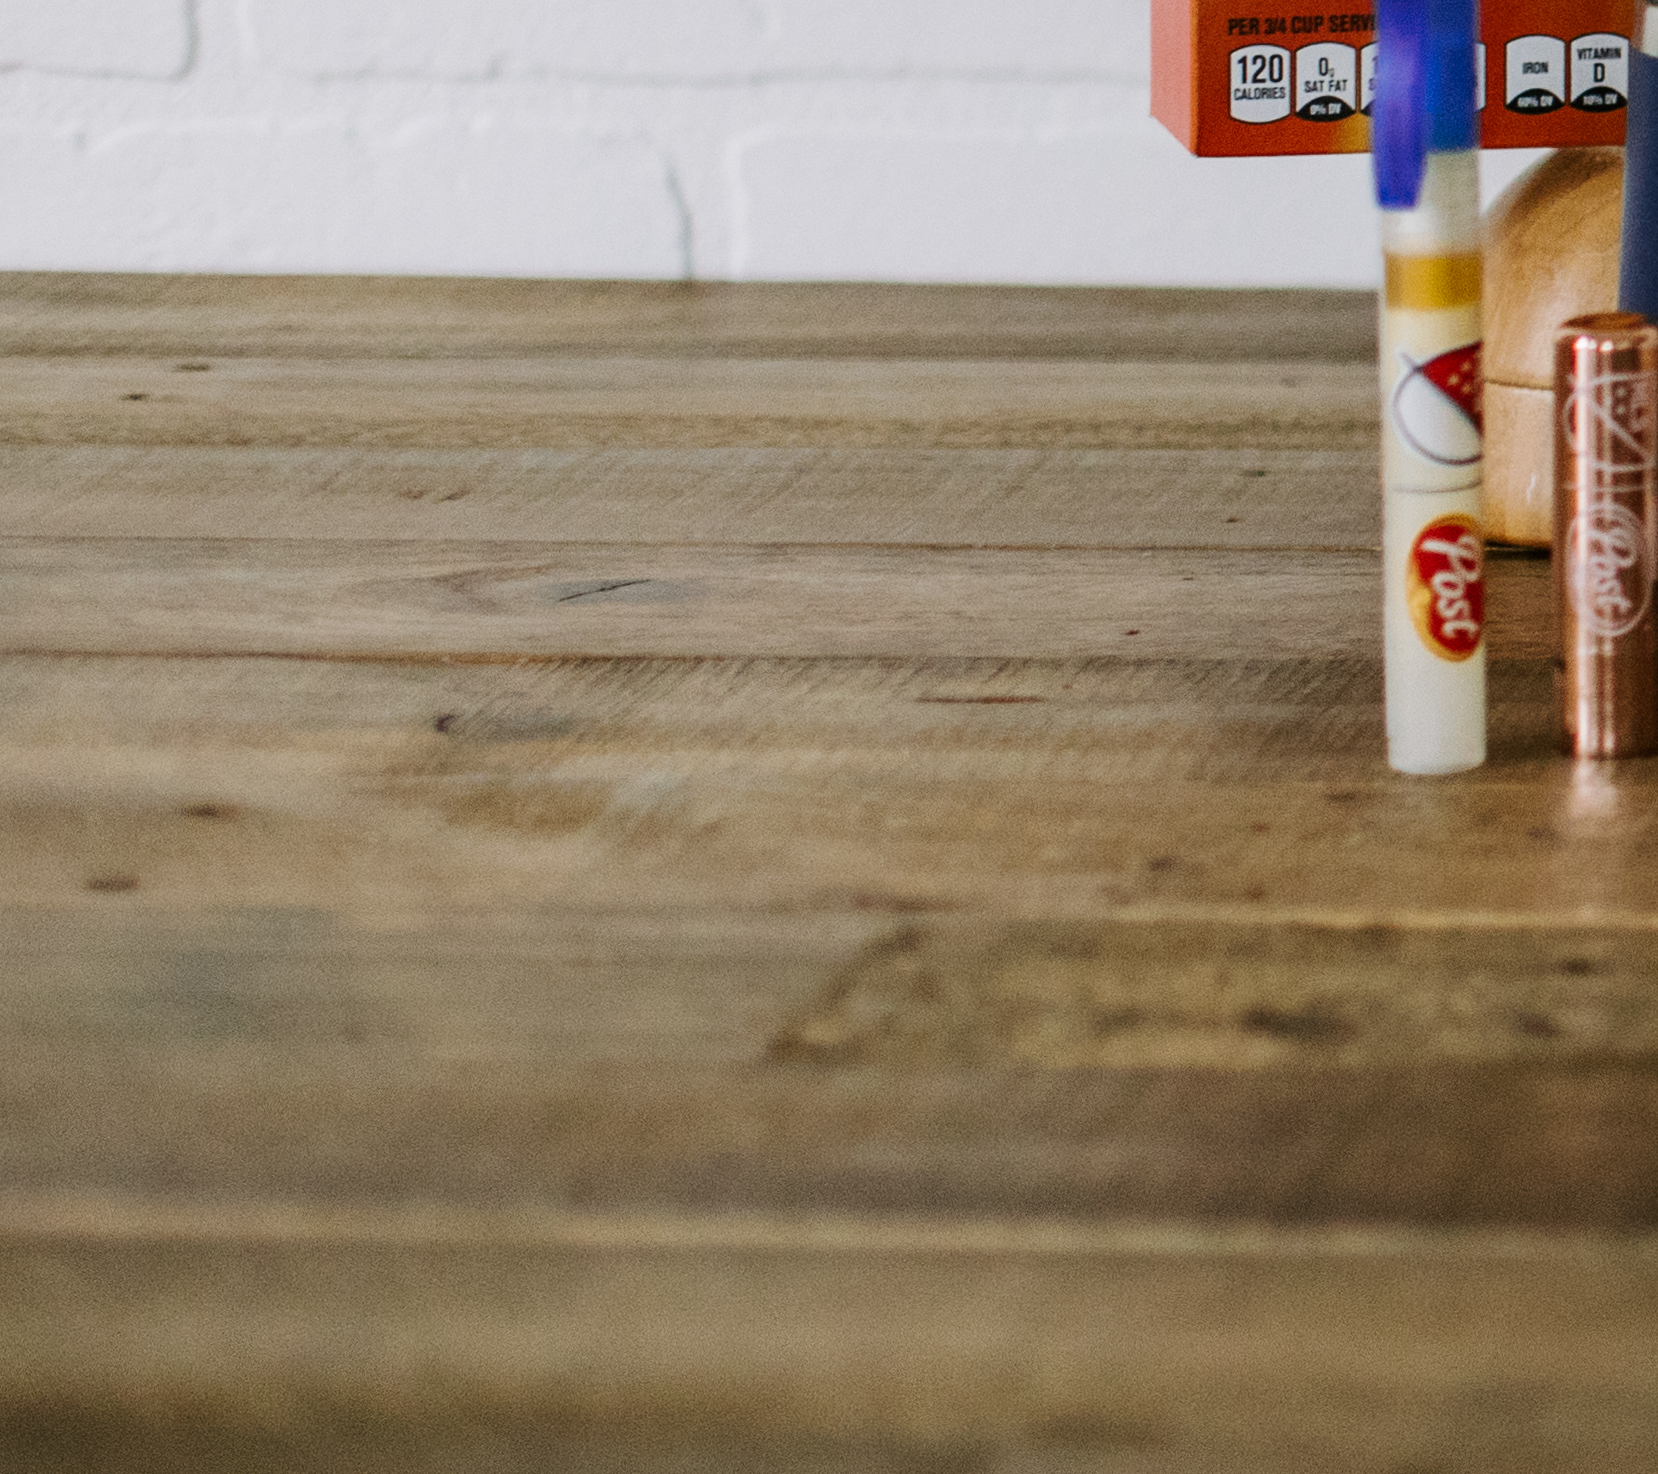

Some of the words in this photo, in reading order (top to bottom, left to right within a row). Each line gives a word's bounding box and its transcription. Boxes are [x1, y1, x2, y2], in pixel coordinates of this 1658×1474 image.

[1227, 17, 1261, 36] PER
[1264, 16, 1287, 35] 3/4
[1291, 15, 1323, 34] CUP
[1577, 47, 1621, 60] VITAMIN
[1236, 53, 1283, 84] 120
[1522, 61, 1548, 74] IRON
[1593, 62, 1605, 82] D
[1234, 86, 1286, 101] CALORIES
[1304, 80, 1325, 94] SAT
[1328, 78, 1348, 92] FAT
[1422, 535, 1480, 638] Post
